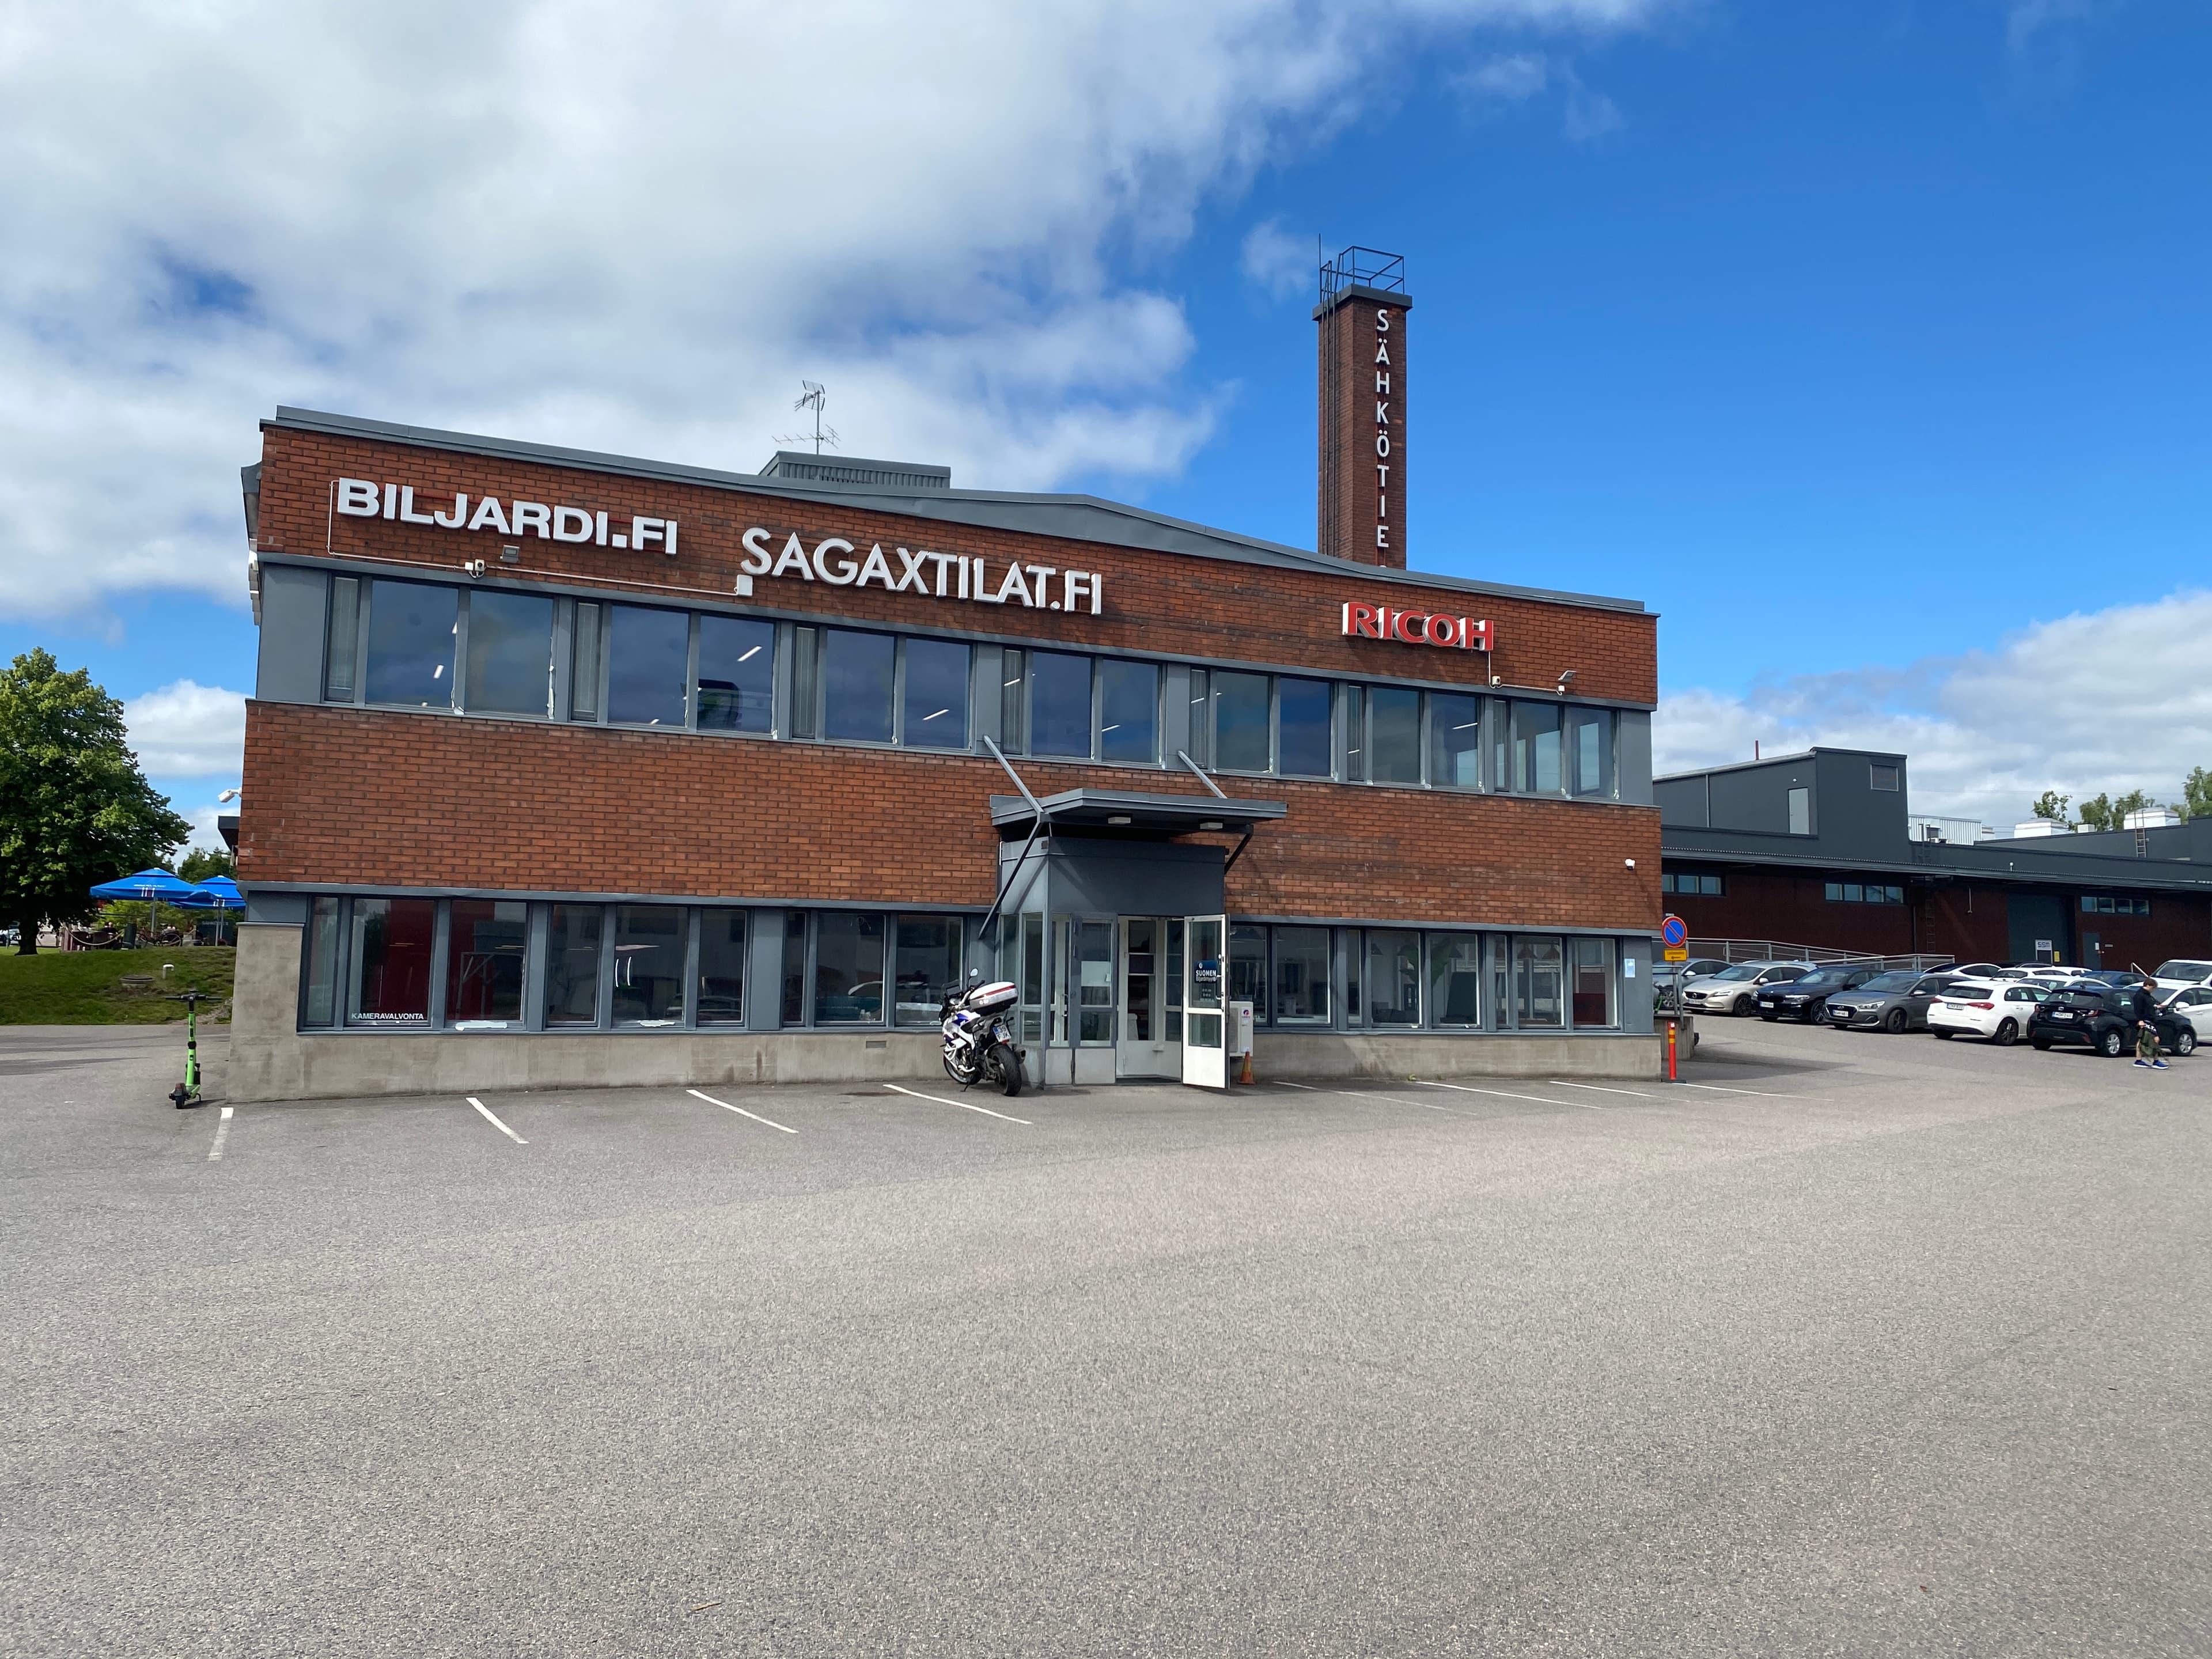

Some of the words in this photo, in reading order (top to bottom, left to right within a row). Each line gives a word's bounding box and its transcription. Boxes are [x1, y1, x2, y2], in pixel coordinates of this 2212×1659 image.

[1375, 309, 1391, 548] SÄHKÖTIE
[337, 477, 678, 555] BILJARDI.FI
[740, 527, 1102, 615] SAGAXTILAT.FI
[1342, 601, 1494, 652] RICOH
